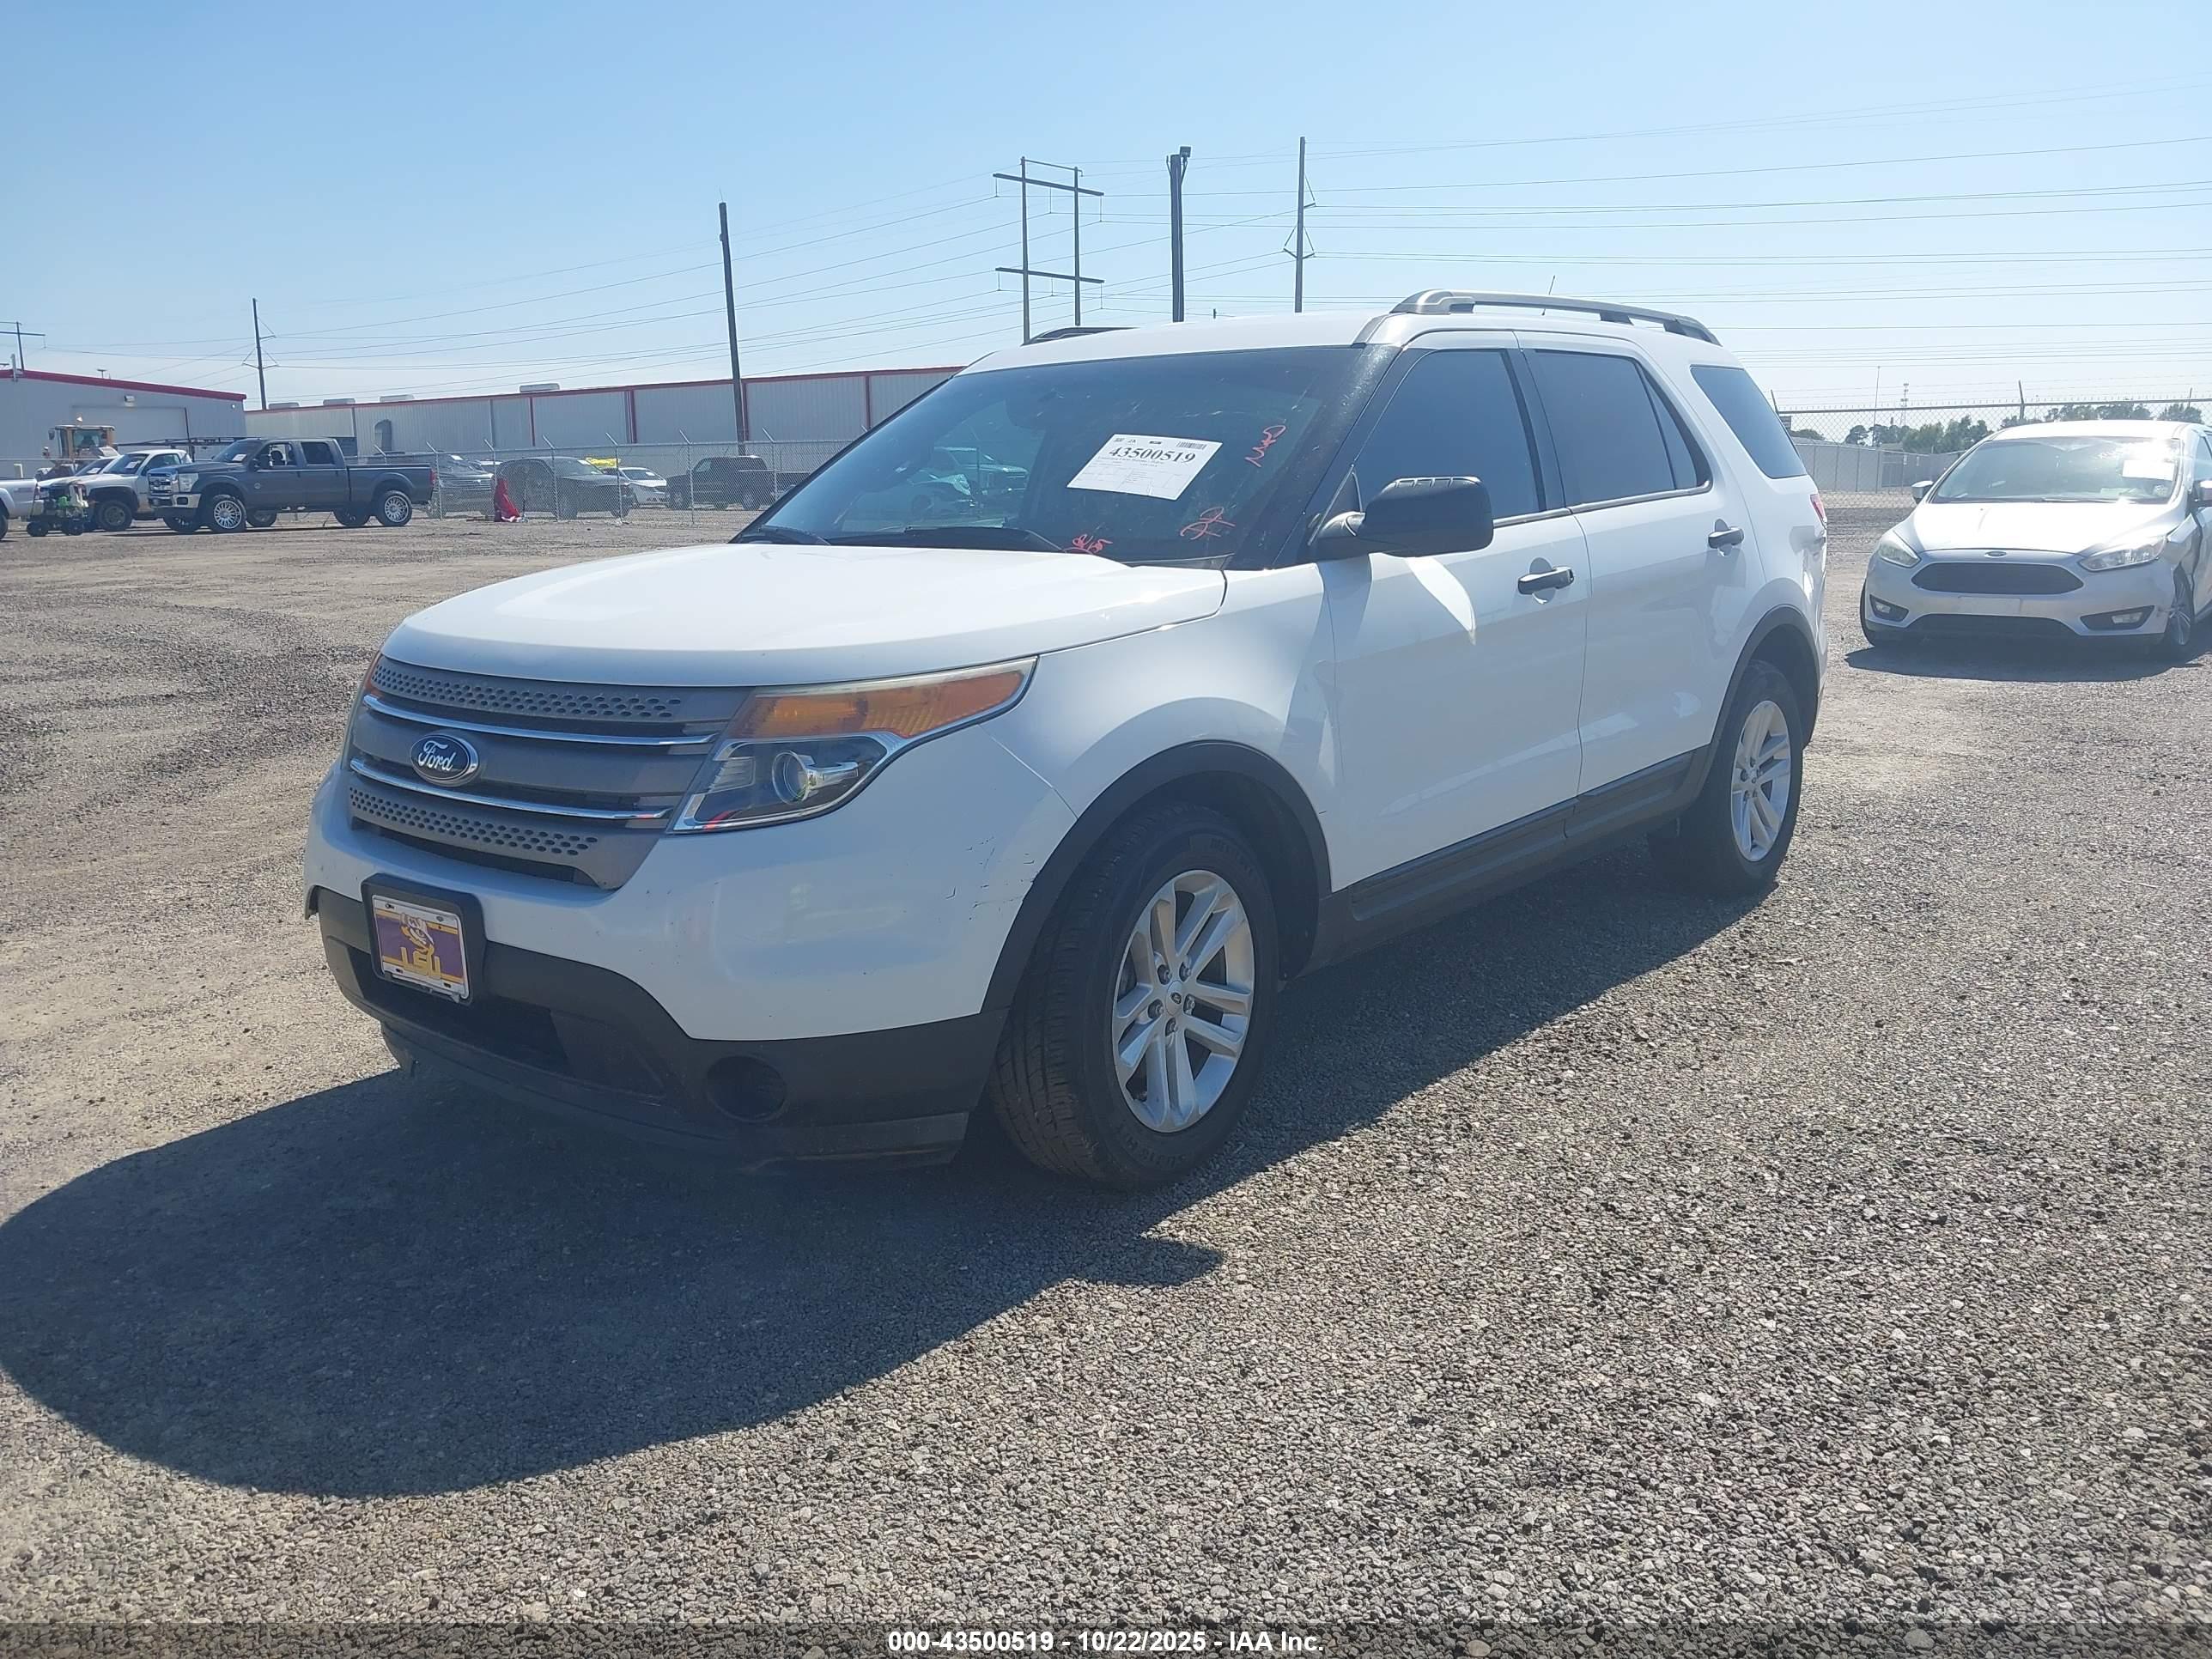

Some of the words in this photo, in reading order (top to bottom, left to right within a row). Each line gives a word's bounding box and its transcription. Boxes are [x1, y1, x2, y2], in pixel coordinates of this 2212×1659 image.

[1109, 446, 1196, 464] 43500519
[417, 739, 457, 772] Ford
[399, 945, 441, 980] LSU
